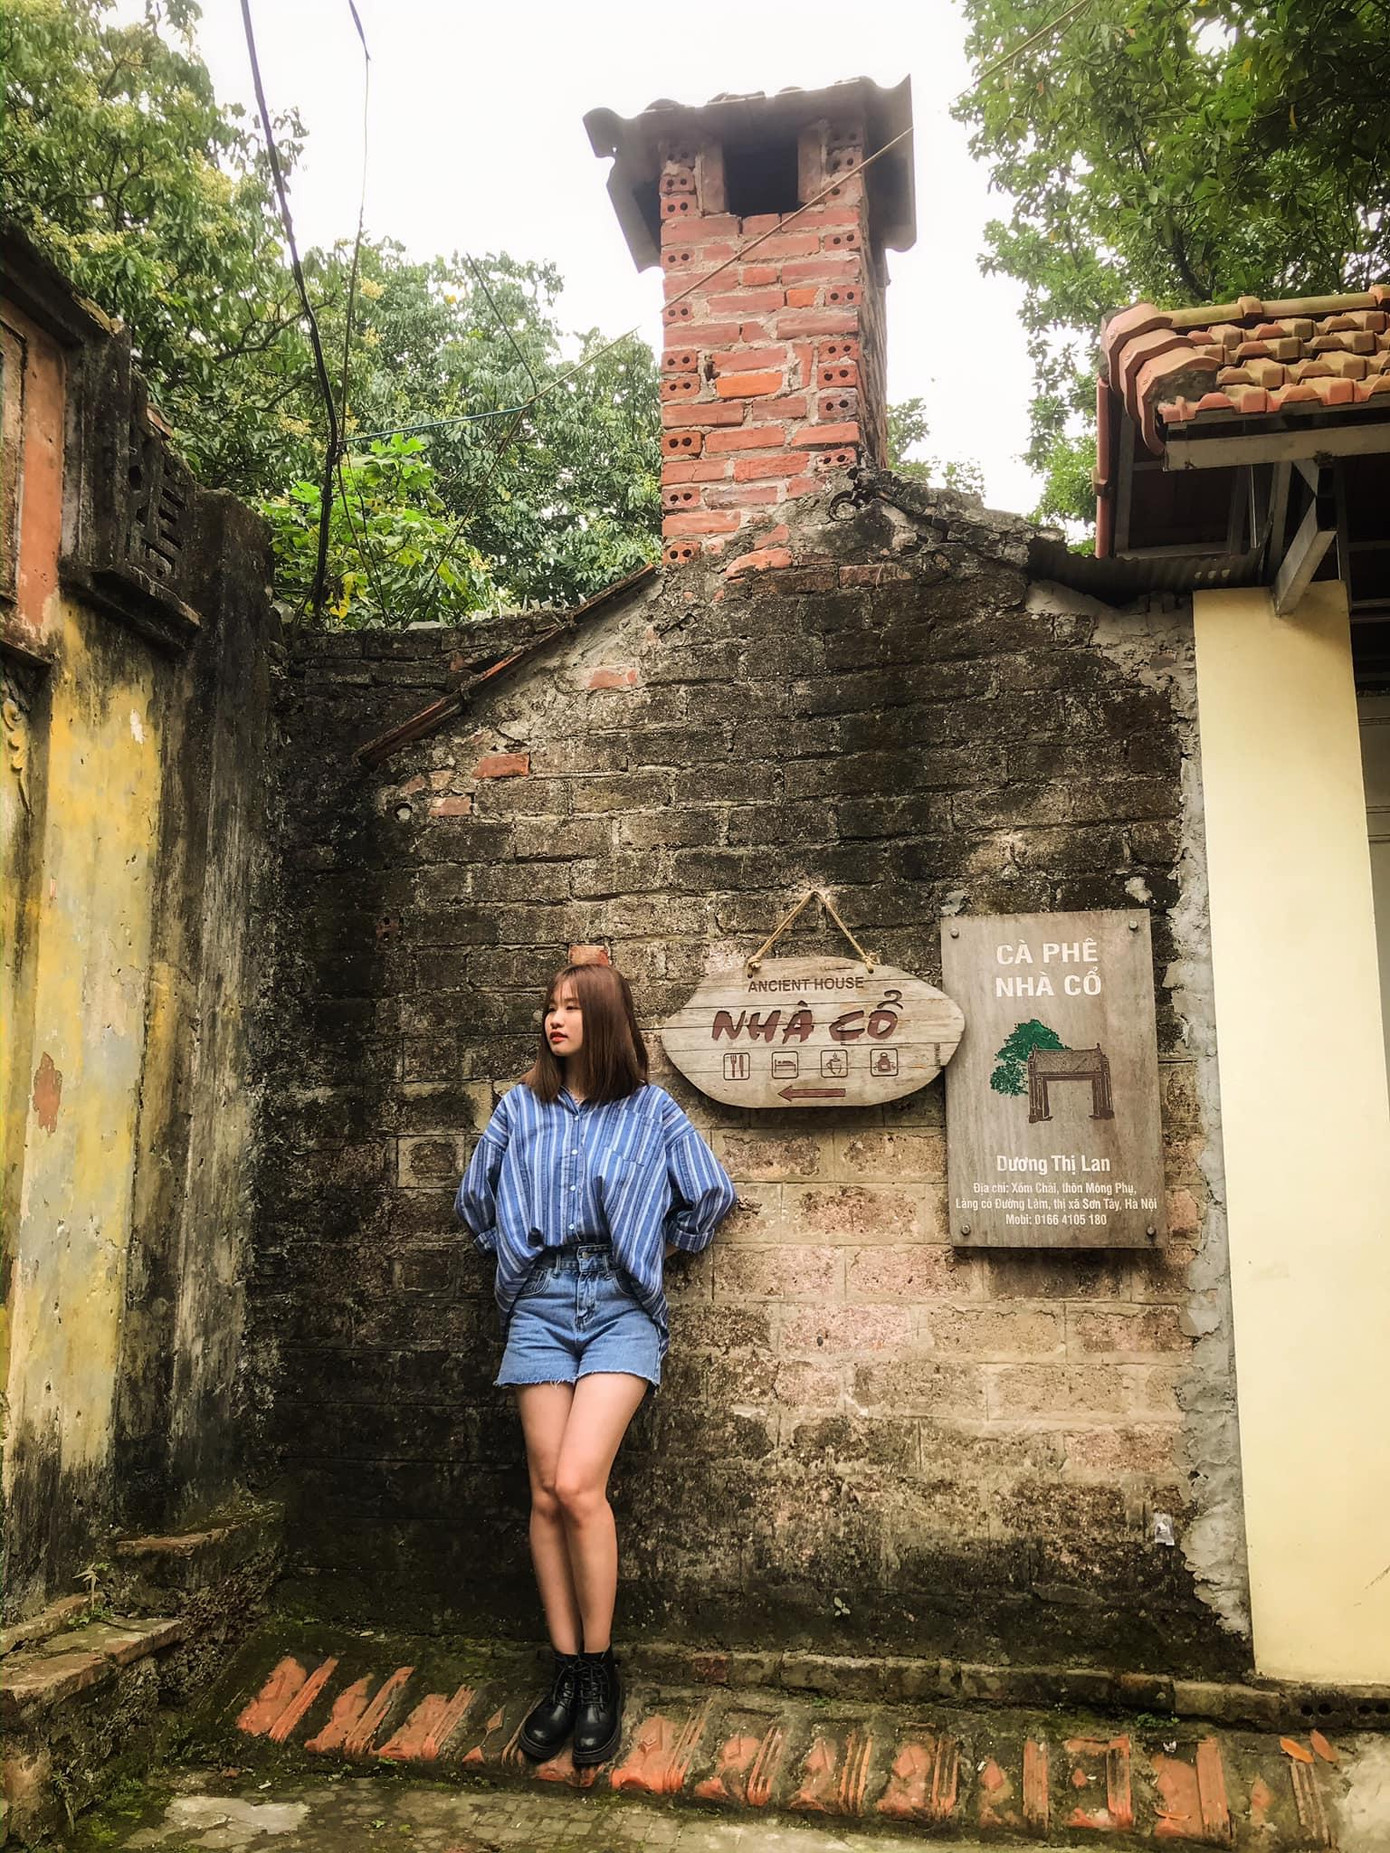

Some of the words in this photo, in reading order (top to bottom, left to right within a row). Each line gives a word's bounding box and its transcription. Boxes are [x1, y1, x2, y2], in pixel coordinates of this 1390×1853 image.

[996, 939, 1033, 965] CÀ
[1042, 937, 1099, 963] PHÊ
[748, 979, 811, 992] ANCIENT
[813, 976, 864, 990] HOUSE
[995, 971, 1054, 997] NHÀ
[1064, 966, 1101, 996] CỔ
[828, 989, 904, 1041] CỔ
[997, 1155, 1048, 1176] Dương
[1051, 1155, 1076, 1175] Thị
[1081, 1156, 1110, 1172] Lan
[973, 1182, 990, 1196] Địa
[1011, 1182, 1033, 1194] Xóm
[1062, 1182, 1083, 1194] thôn
[1085, 1182, 1113, 1196] Mông
[1115, 1182, 1137, 1196] Phụ,
[994, 1198, 1025, 1212] Đường
[1053, 1199, 1066, 1212] thị
[1082, 1198, 1101, 1210] Sơn
[1125, 1198, 1139, 1210] Hà
[1141, 1198, 1158, 1213] Nội
[1005, 1214, 1032, 1226] Mobi:
[1034, 1213, 1059, 1226] 0166
[1061, 1213, 1086, 1226] 4105
[1088, 1213, 1107, 1226] 180
